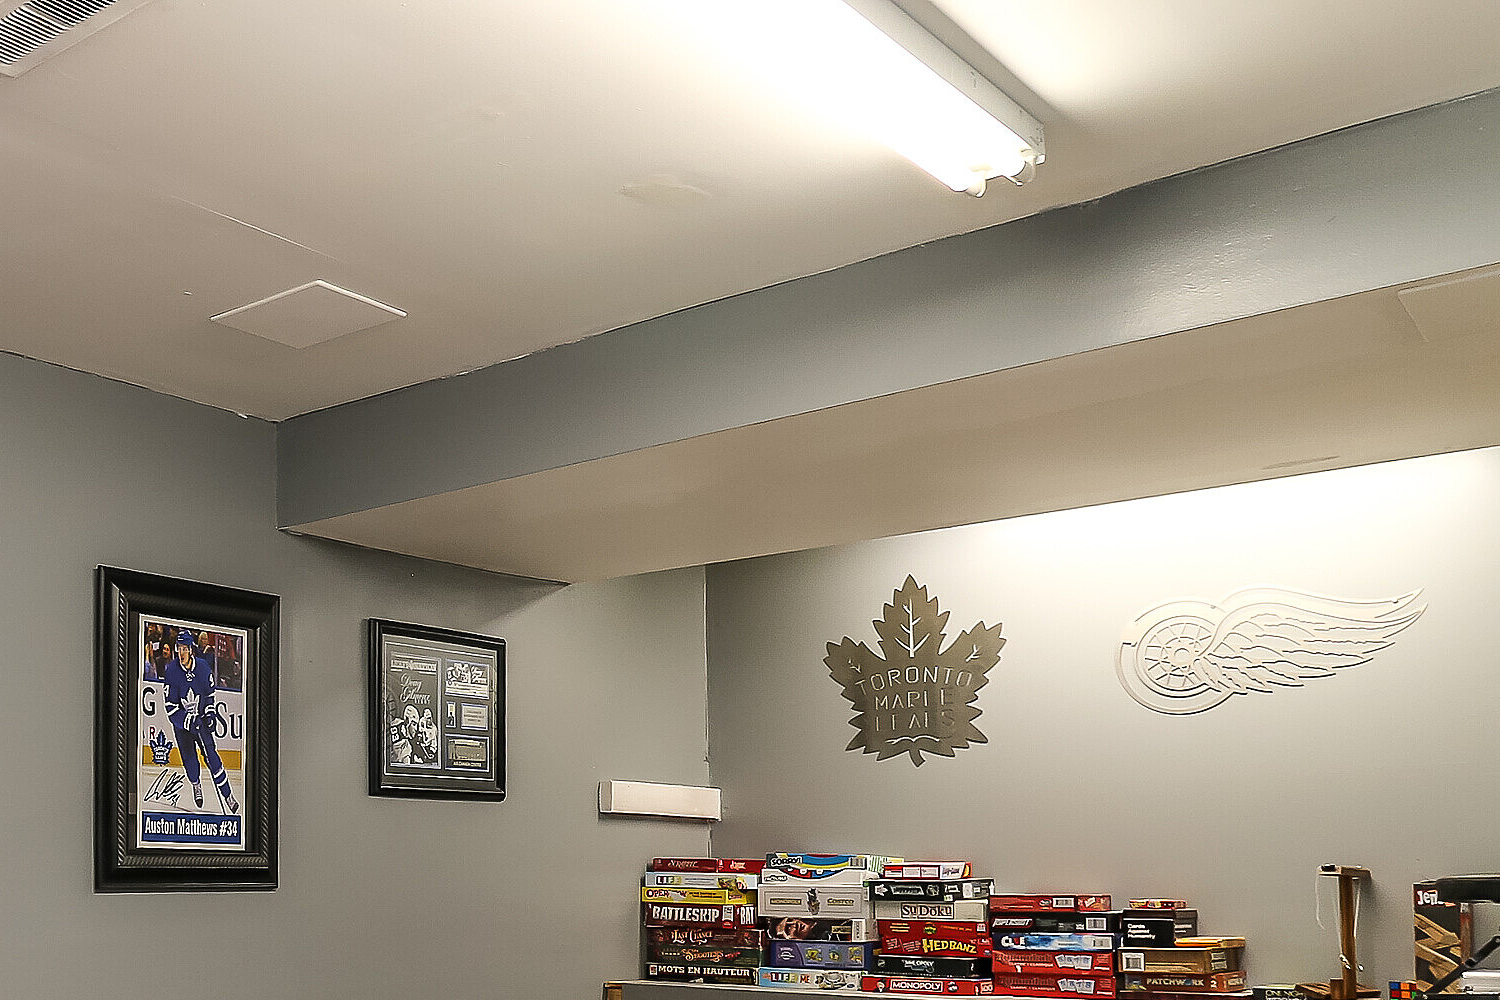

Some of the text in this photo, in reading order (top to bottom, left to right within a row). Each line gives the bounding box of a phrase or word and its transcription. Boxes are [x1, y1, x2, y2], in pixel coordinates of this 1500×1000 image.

[855, 666, 972, 695] TORONTO
[145, 816, 238, 837] Auston Matthews #34
[652, 905, 720, 923] BATTLESHIP
[658, 965, 750, 976] MOTS EN HAUTEUR
[892, 981, 941, 990] MONOPOLY
